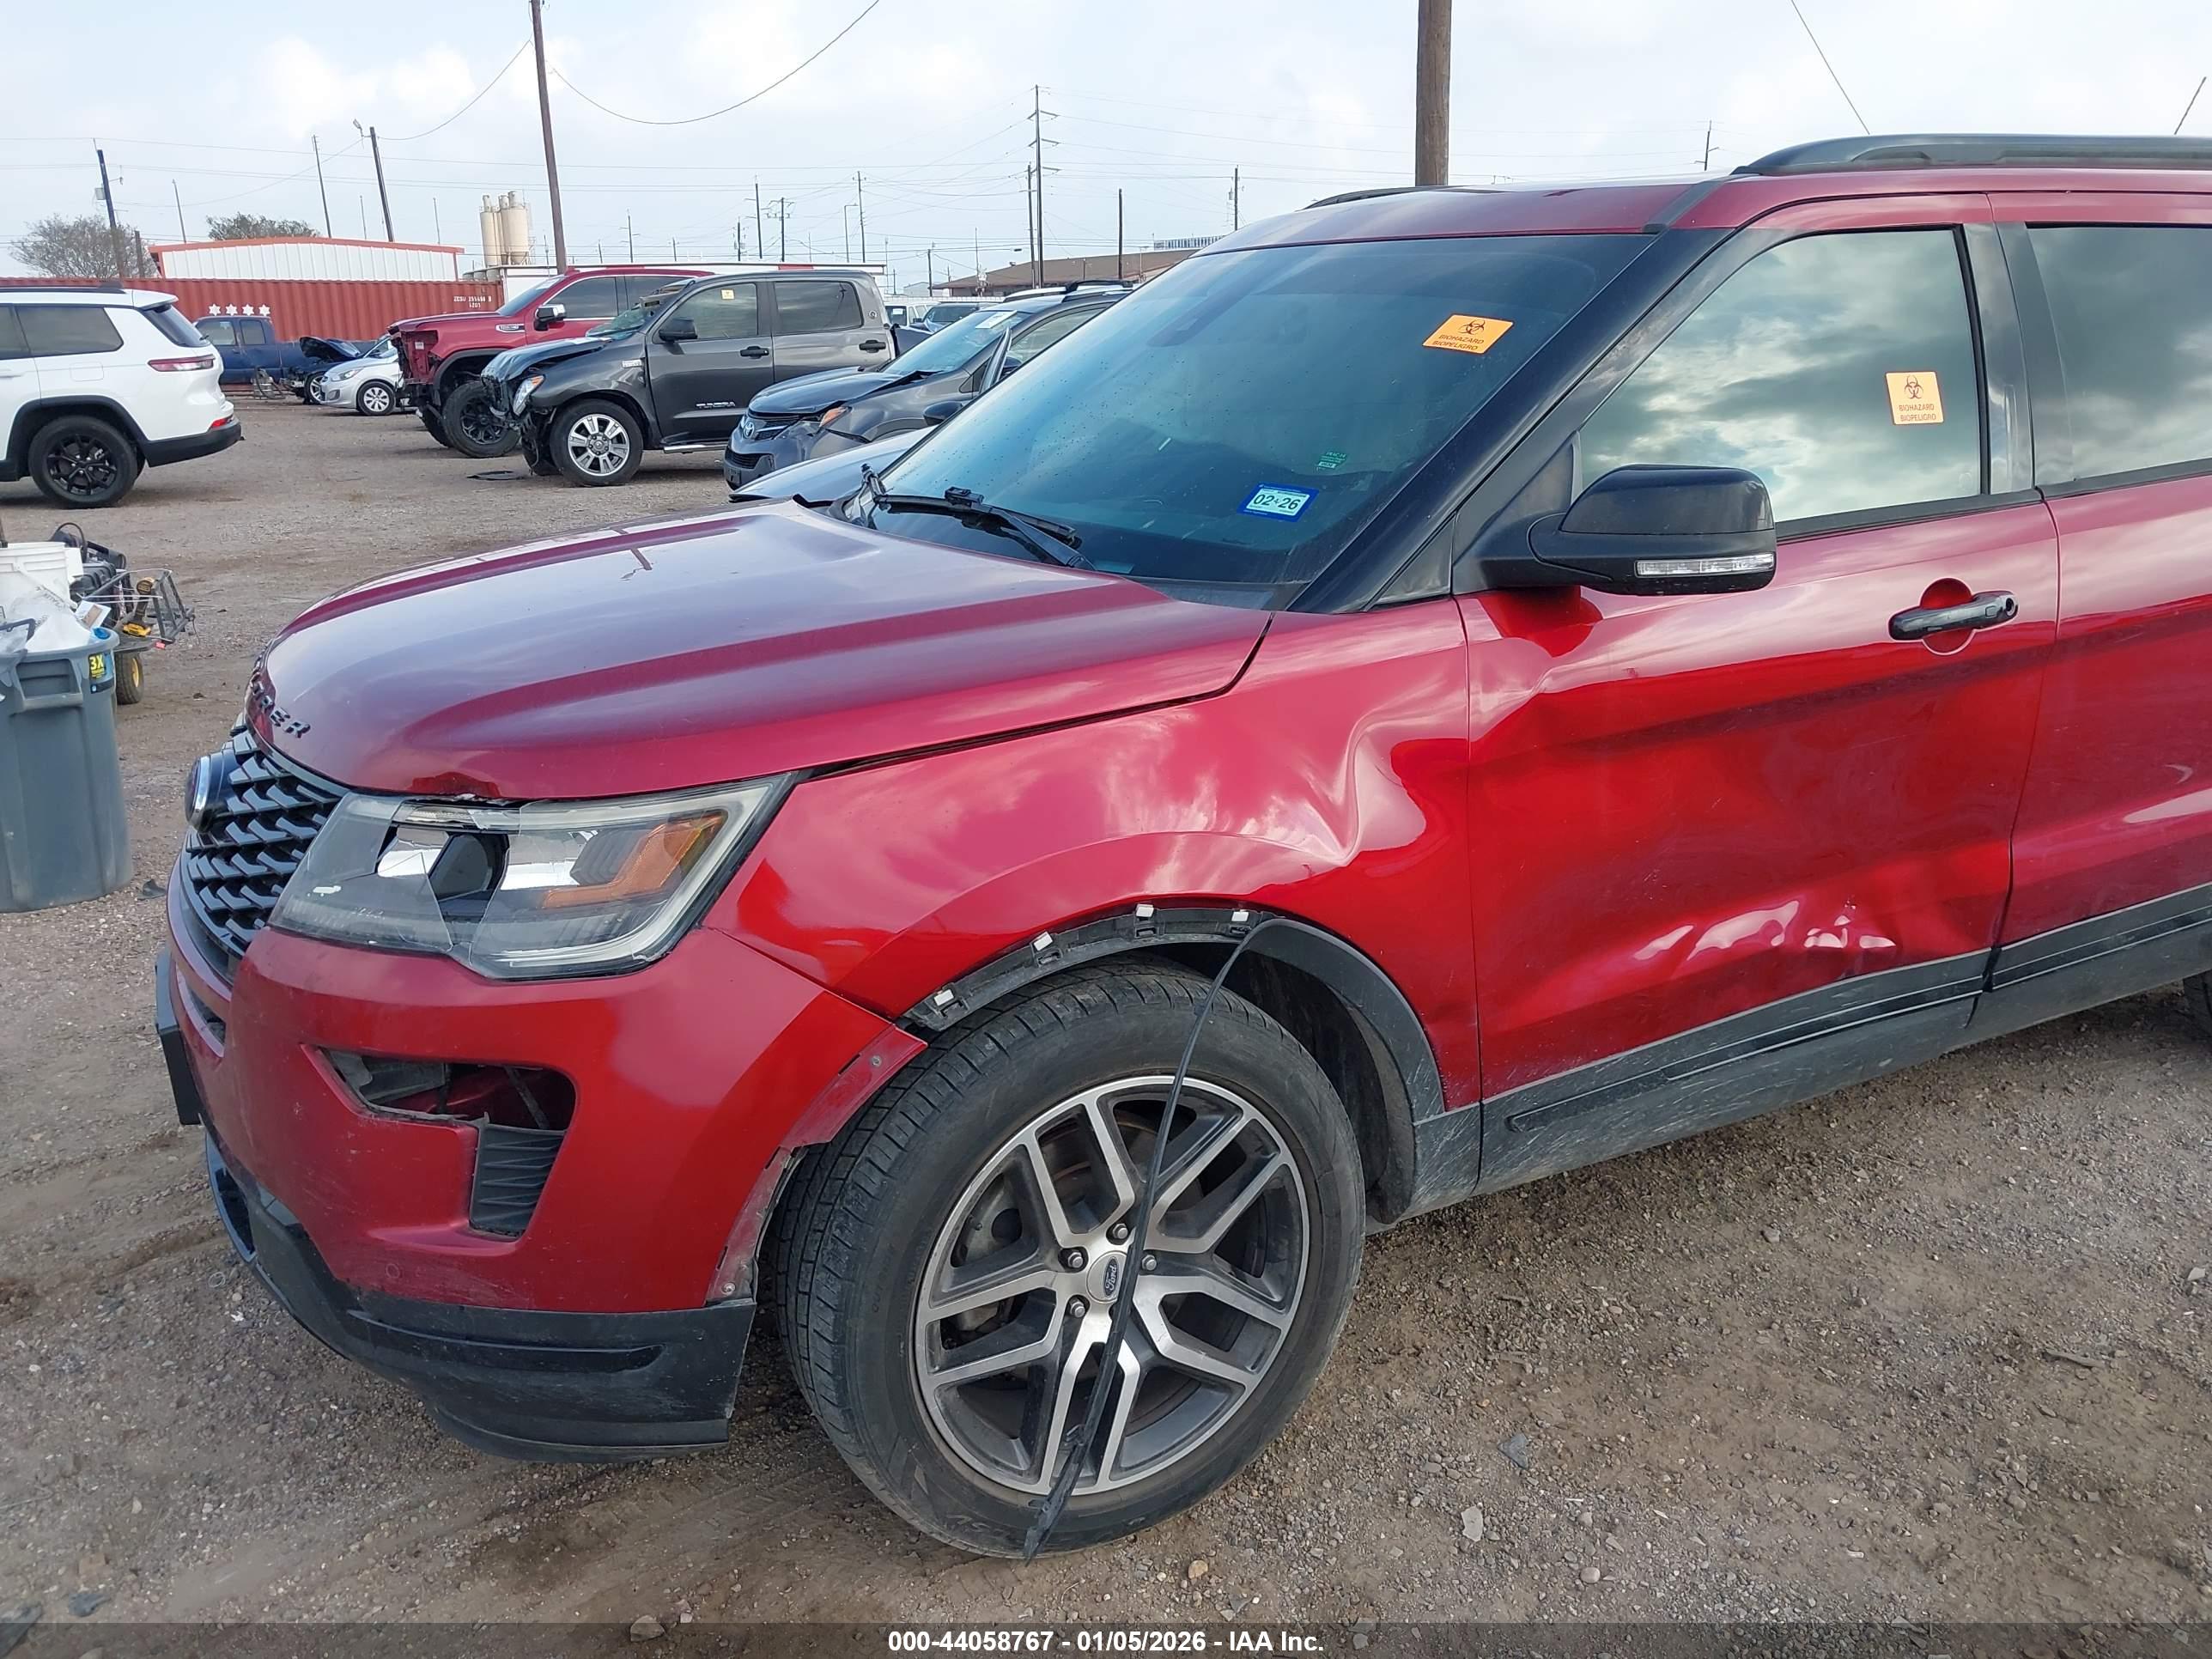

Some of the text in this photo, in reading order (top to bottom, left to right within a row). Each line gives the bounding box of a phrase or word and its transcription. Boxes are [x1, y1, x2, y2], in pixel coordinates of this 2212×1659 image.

[1438, 334, 1484, 344] BIOHAZARD
[1432, 340, 1478, 350] BIOPELIGRO
[1899, 413, 1936, 422] BIOPELIGRO
[88, 654, 104, 670] 3X
[1104, 1265, 1117, 1291] Ford
